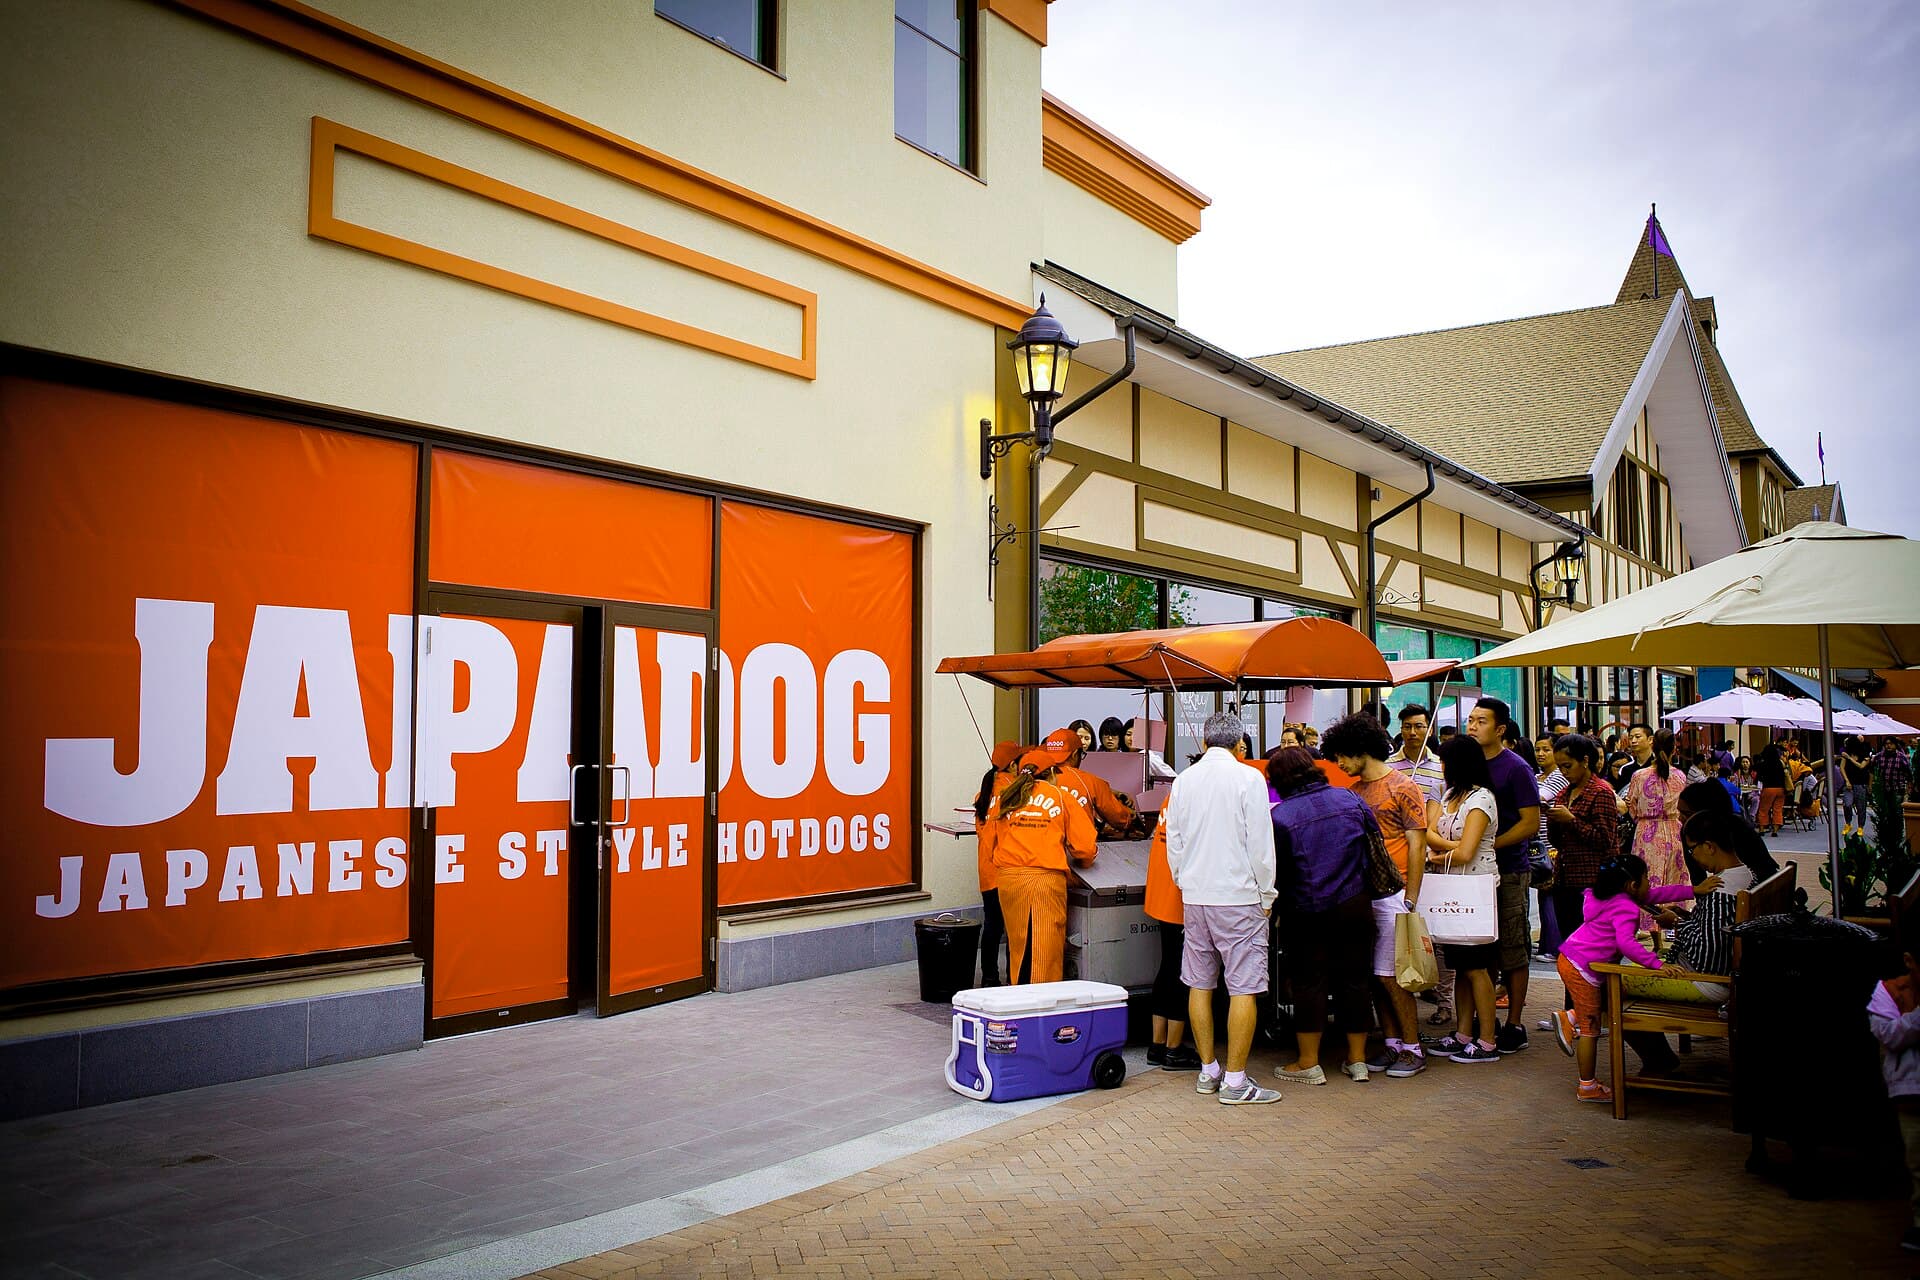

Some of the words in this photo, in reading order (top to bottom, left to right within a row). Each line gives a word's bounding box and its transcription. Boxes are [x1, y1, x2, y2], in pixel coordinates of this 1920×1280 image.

[44, 598, 891, 827] JAPADOG
[36, 834, 465, 918] JAPANESE
[498, 823, 688, 879] STYLE
[717, 813, 890, 864] HOTDOGS
